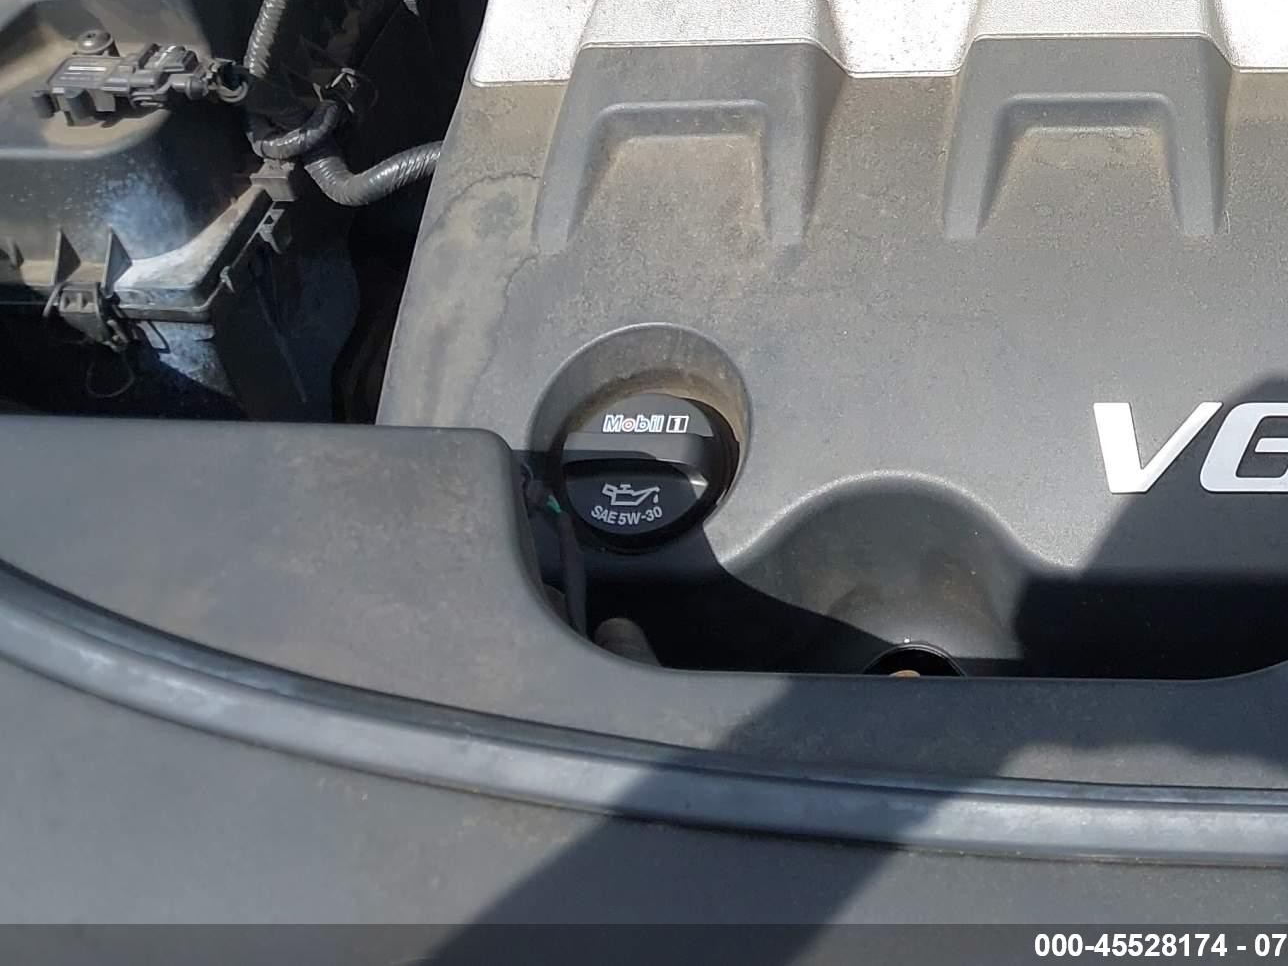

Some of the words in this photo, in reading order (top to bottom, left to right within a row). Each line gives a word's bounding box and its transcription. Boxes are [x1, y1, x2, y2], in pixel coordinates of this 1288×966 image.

[603, 415, 664, 433] Mobil
[666, 415, 690, 433] 1
[591, 505, 617, 524] SAE
[618, 505, 663, 526] 5W-30
